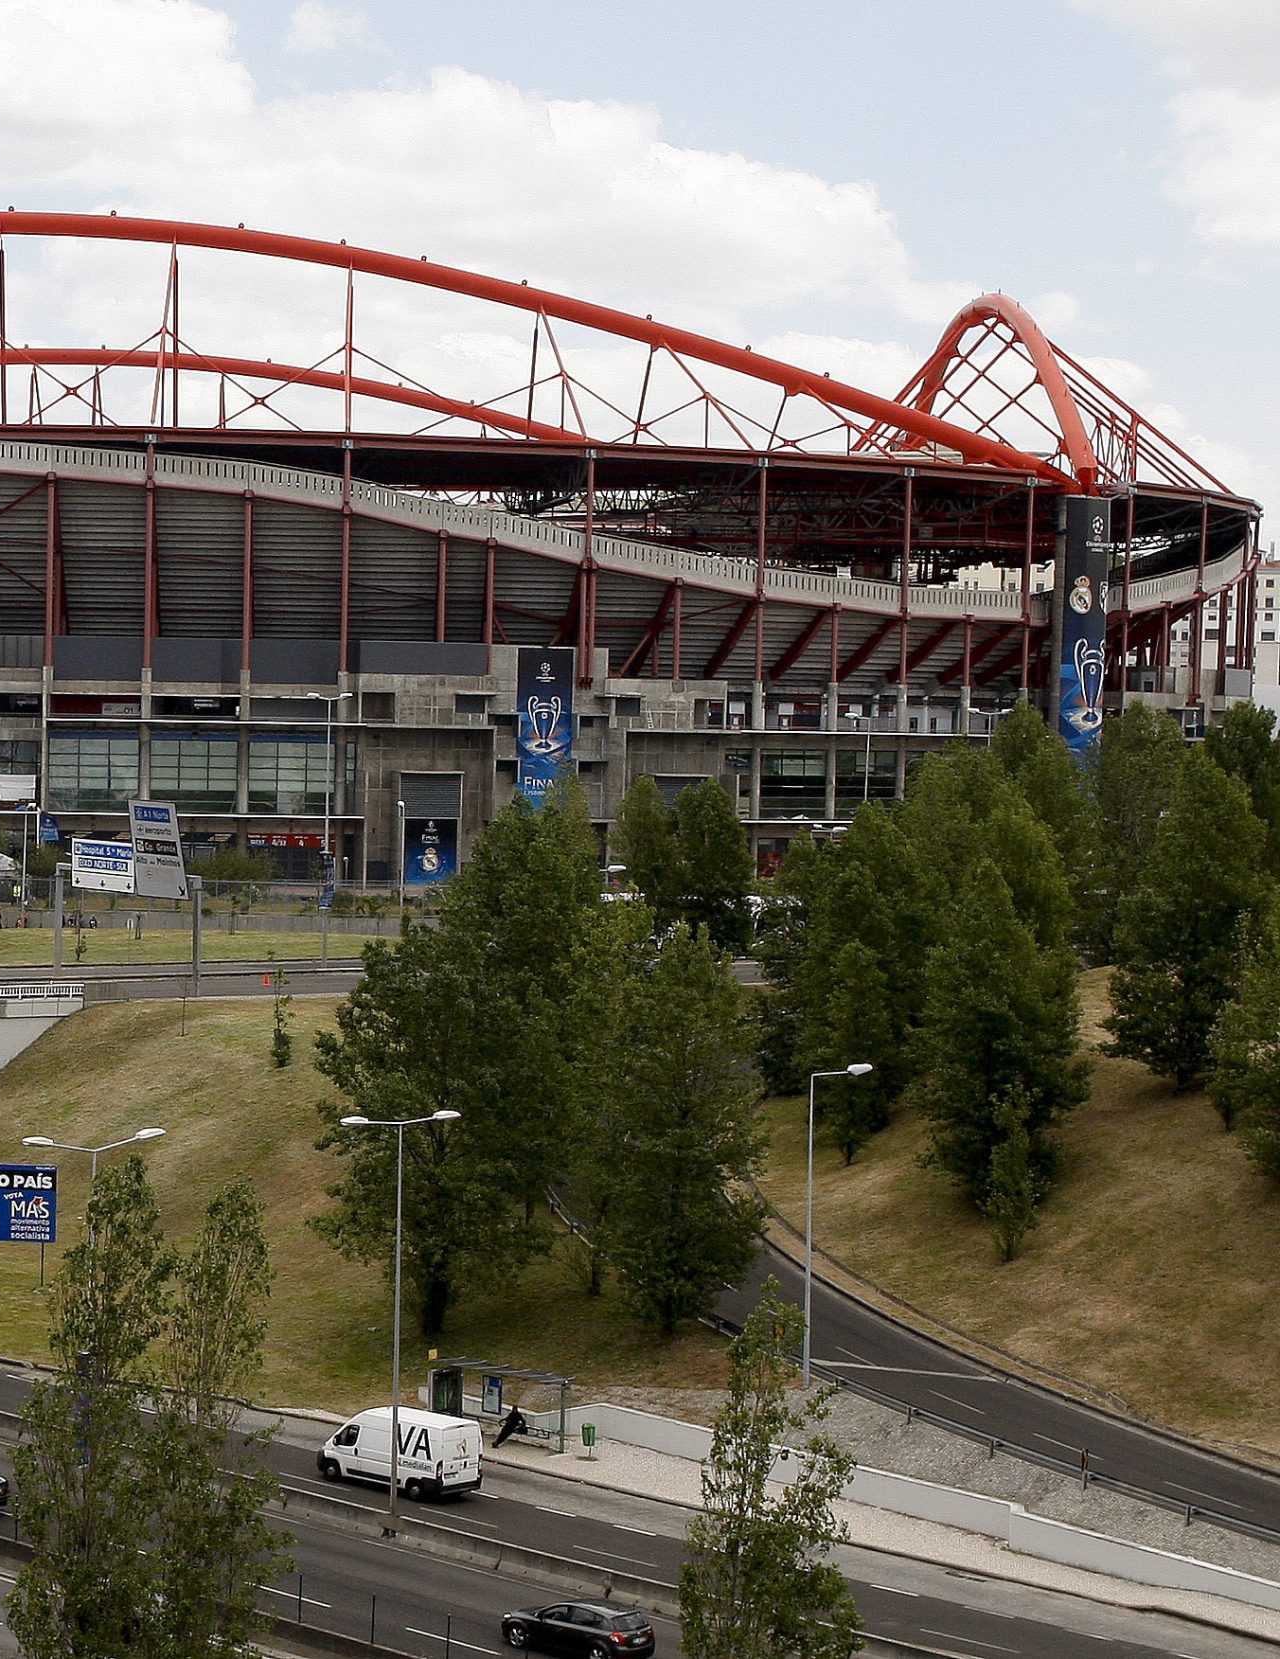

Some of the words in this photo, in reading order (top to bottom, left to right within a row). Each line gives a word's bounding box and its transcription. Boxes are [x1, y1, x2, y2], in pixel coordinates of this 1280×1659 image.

[524, 776, 555, 789] FINA
[13, 1173, 53, 1189] PAÍS
[3, 1191, 24, 1200] VOTA
[10, 1218, 50, 1226] movimento
[10, 1232, 50, 1240] socialista
